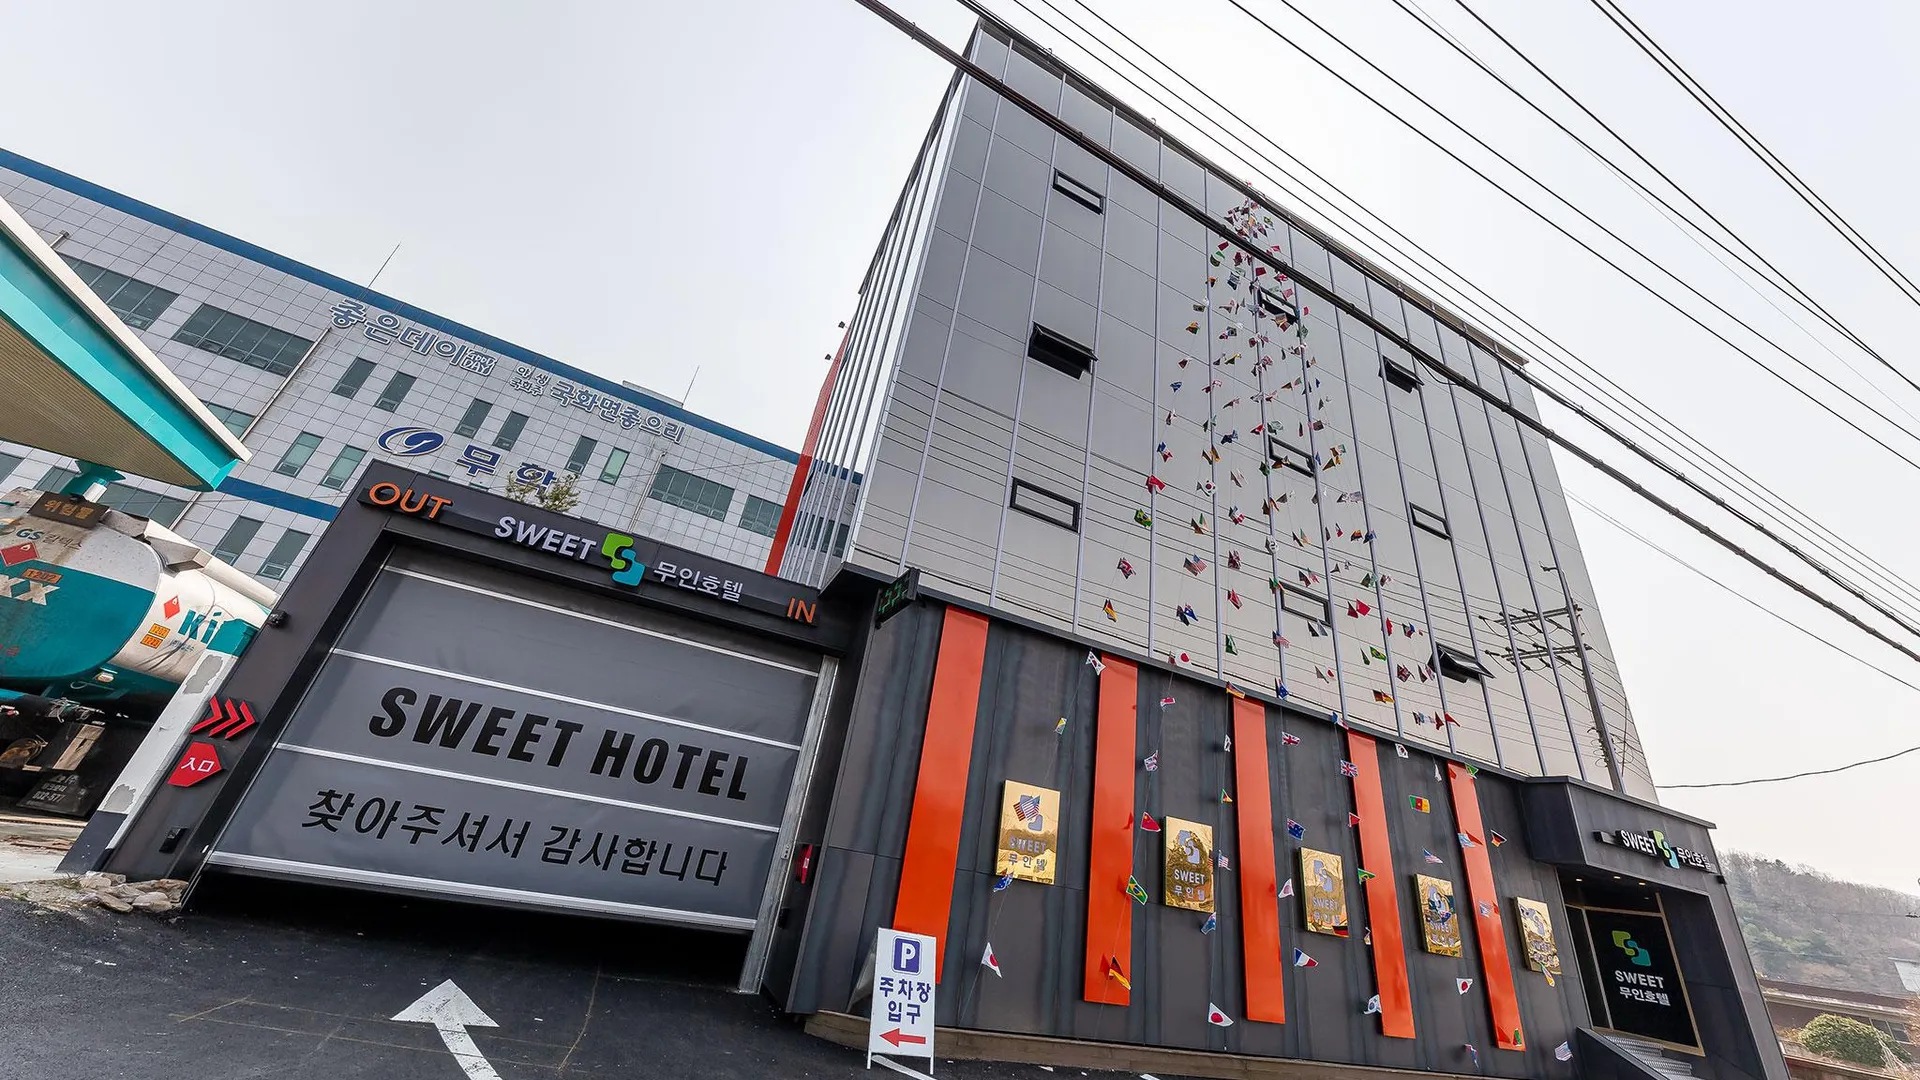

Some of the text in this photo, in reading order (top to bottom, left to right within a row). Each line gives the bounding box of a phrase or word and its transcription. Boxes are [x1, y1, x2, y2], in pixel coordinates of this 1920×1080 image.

[329, 299, 468, 366] 좋은데이
[463, 358, 491, 374] DAY
[551, 380, 686, 443] 국화면좋으리
[369, 482, 452, 518] OUT
[16, 528, 45, 541] GS
[494, 515, 596, 560] SWEET
[653, 561, 744, 603] 무인호텔
[786, 597, 817, 624] IN
[368, 687, 749, 801] SWEET HOTEL
[302, 788, 729, 886] 찾아주셔서 감사합니다
[1009, 836, 1046, 854] SWEET
[1621, 829, 1657, 856] SWEET
[1174, 868, 1205, 885] SWEET
[900, 942, 916, 969] P
[879, 977, 932, 1004] 주차장
[1615, 970, 1664, 989] SWEET
[1620, 986, 1671, 1007] 무인호텔
[888, 1000, 921, 1025] 입구
